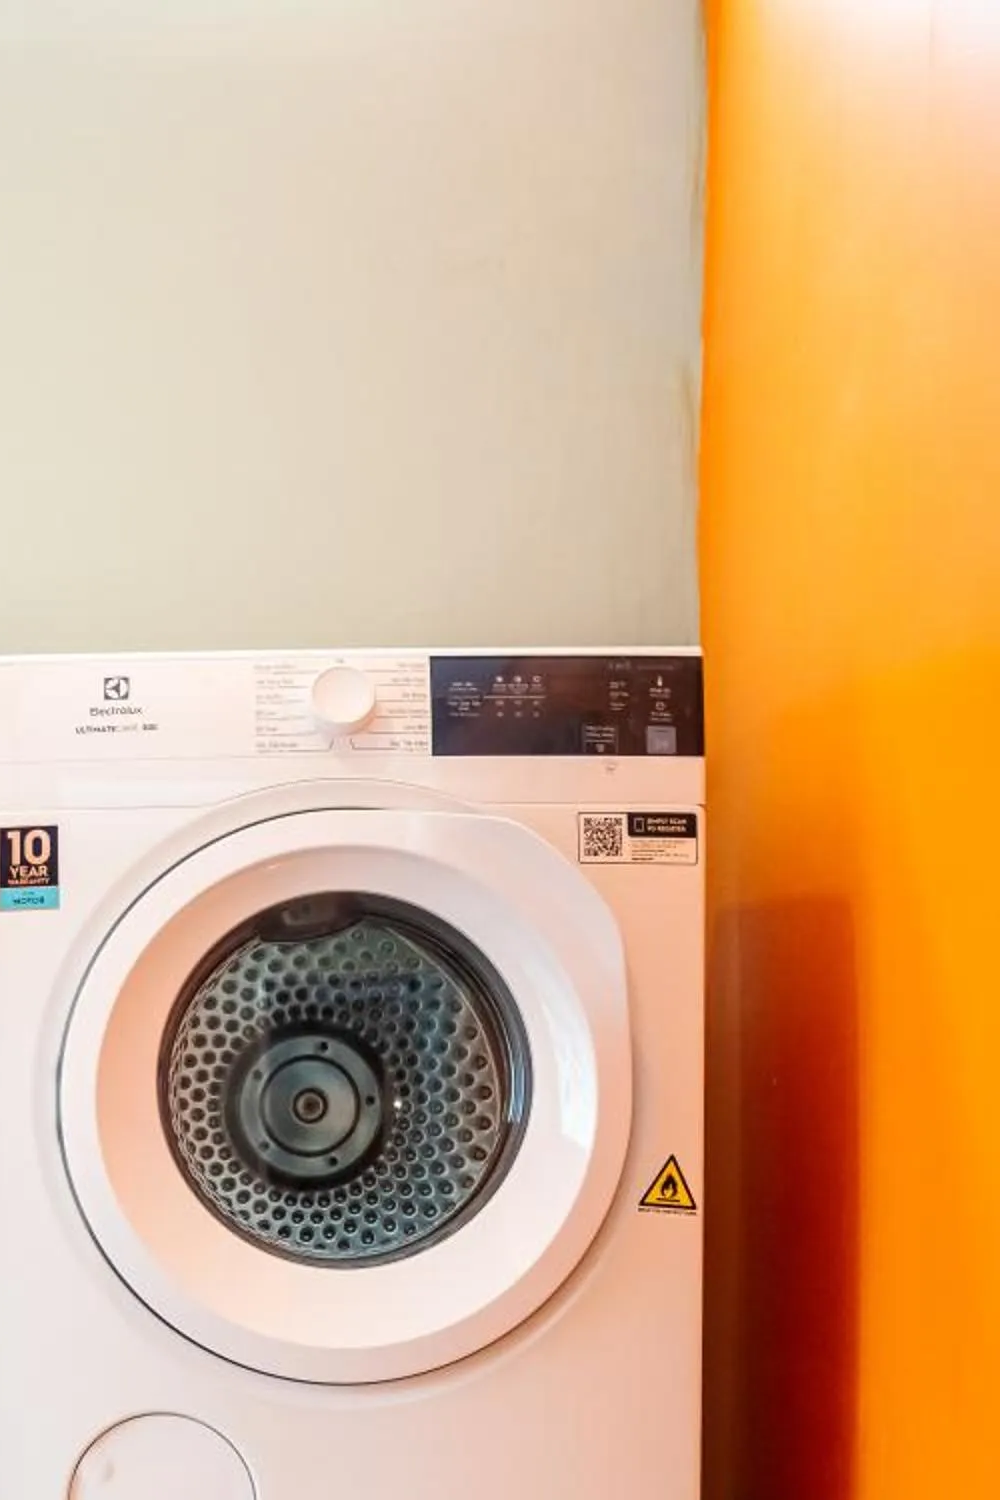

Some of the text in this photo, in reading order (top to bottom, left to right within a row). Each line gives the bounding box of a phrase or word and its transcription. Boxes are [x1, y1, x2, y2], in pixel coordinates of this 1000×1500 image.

[89, 706, 143, 716] Electrolux
[7, 829, 51, 865] 10
[9, 865, 49, 878] YEAR
